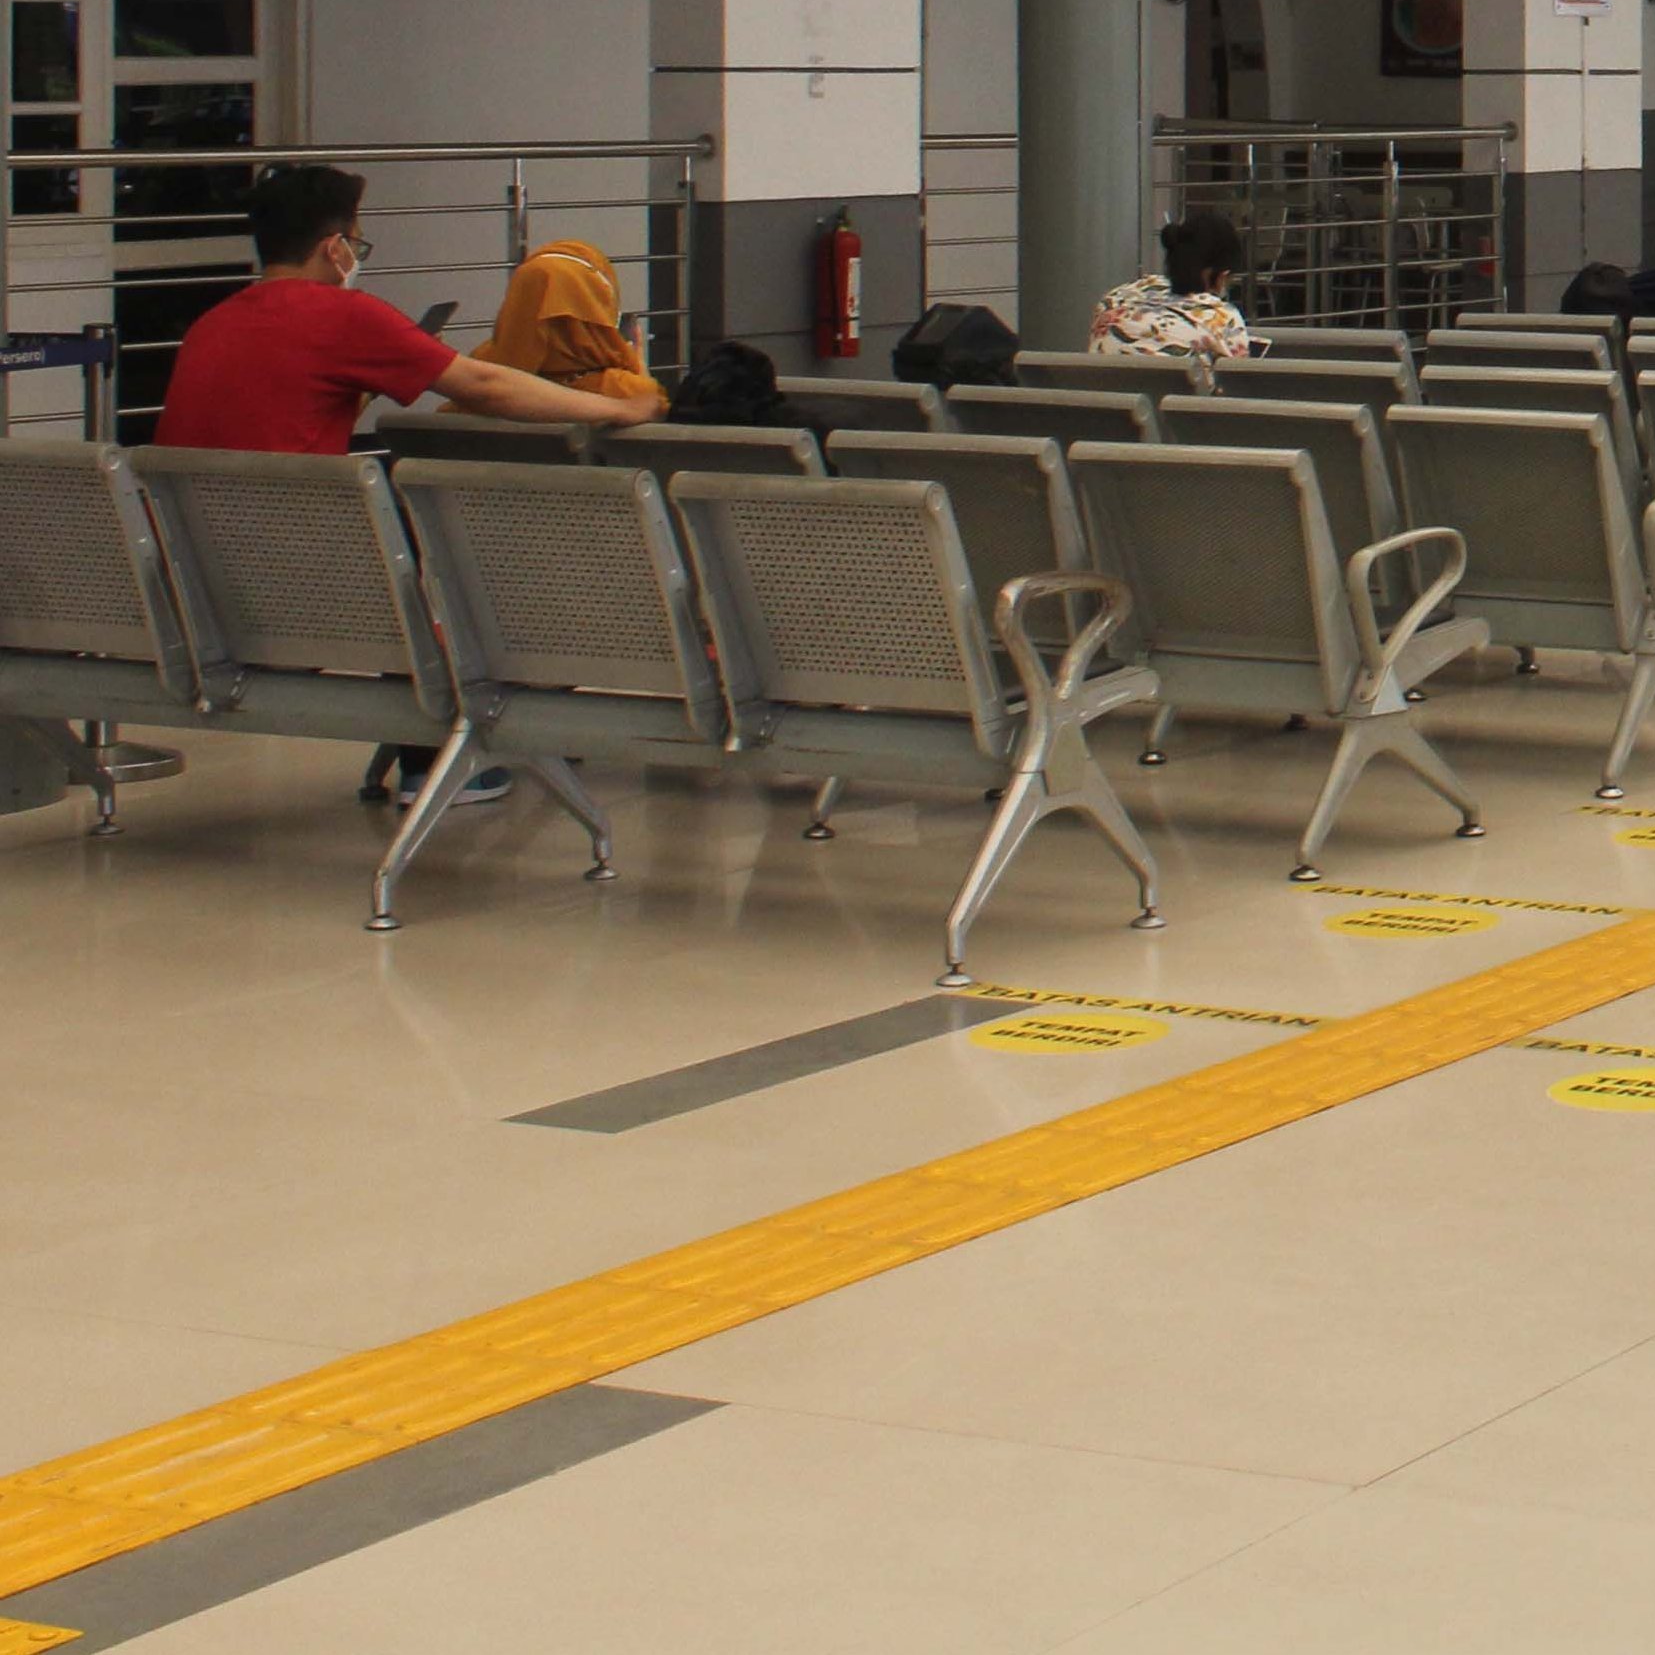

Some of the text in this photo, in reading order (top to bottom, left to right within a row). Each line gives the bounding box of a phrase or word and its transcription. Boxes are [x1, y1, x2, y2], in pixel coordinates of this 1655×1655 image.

[1311, 884, 1623, 915] BATAS ANTRIAN
[977, 985, 1320, 1028] BATAS ANTRIAN
[990, 1028, 1123, 1047] BERDIRI
[1021, 1019, 1149, 1038] TEMPAT
